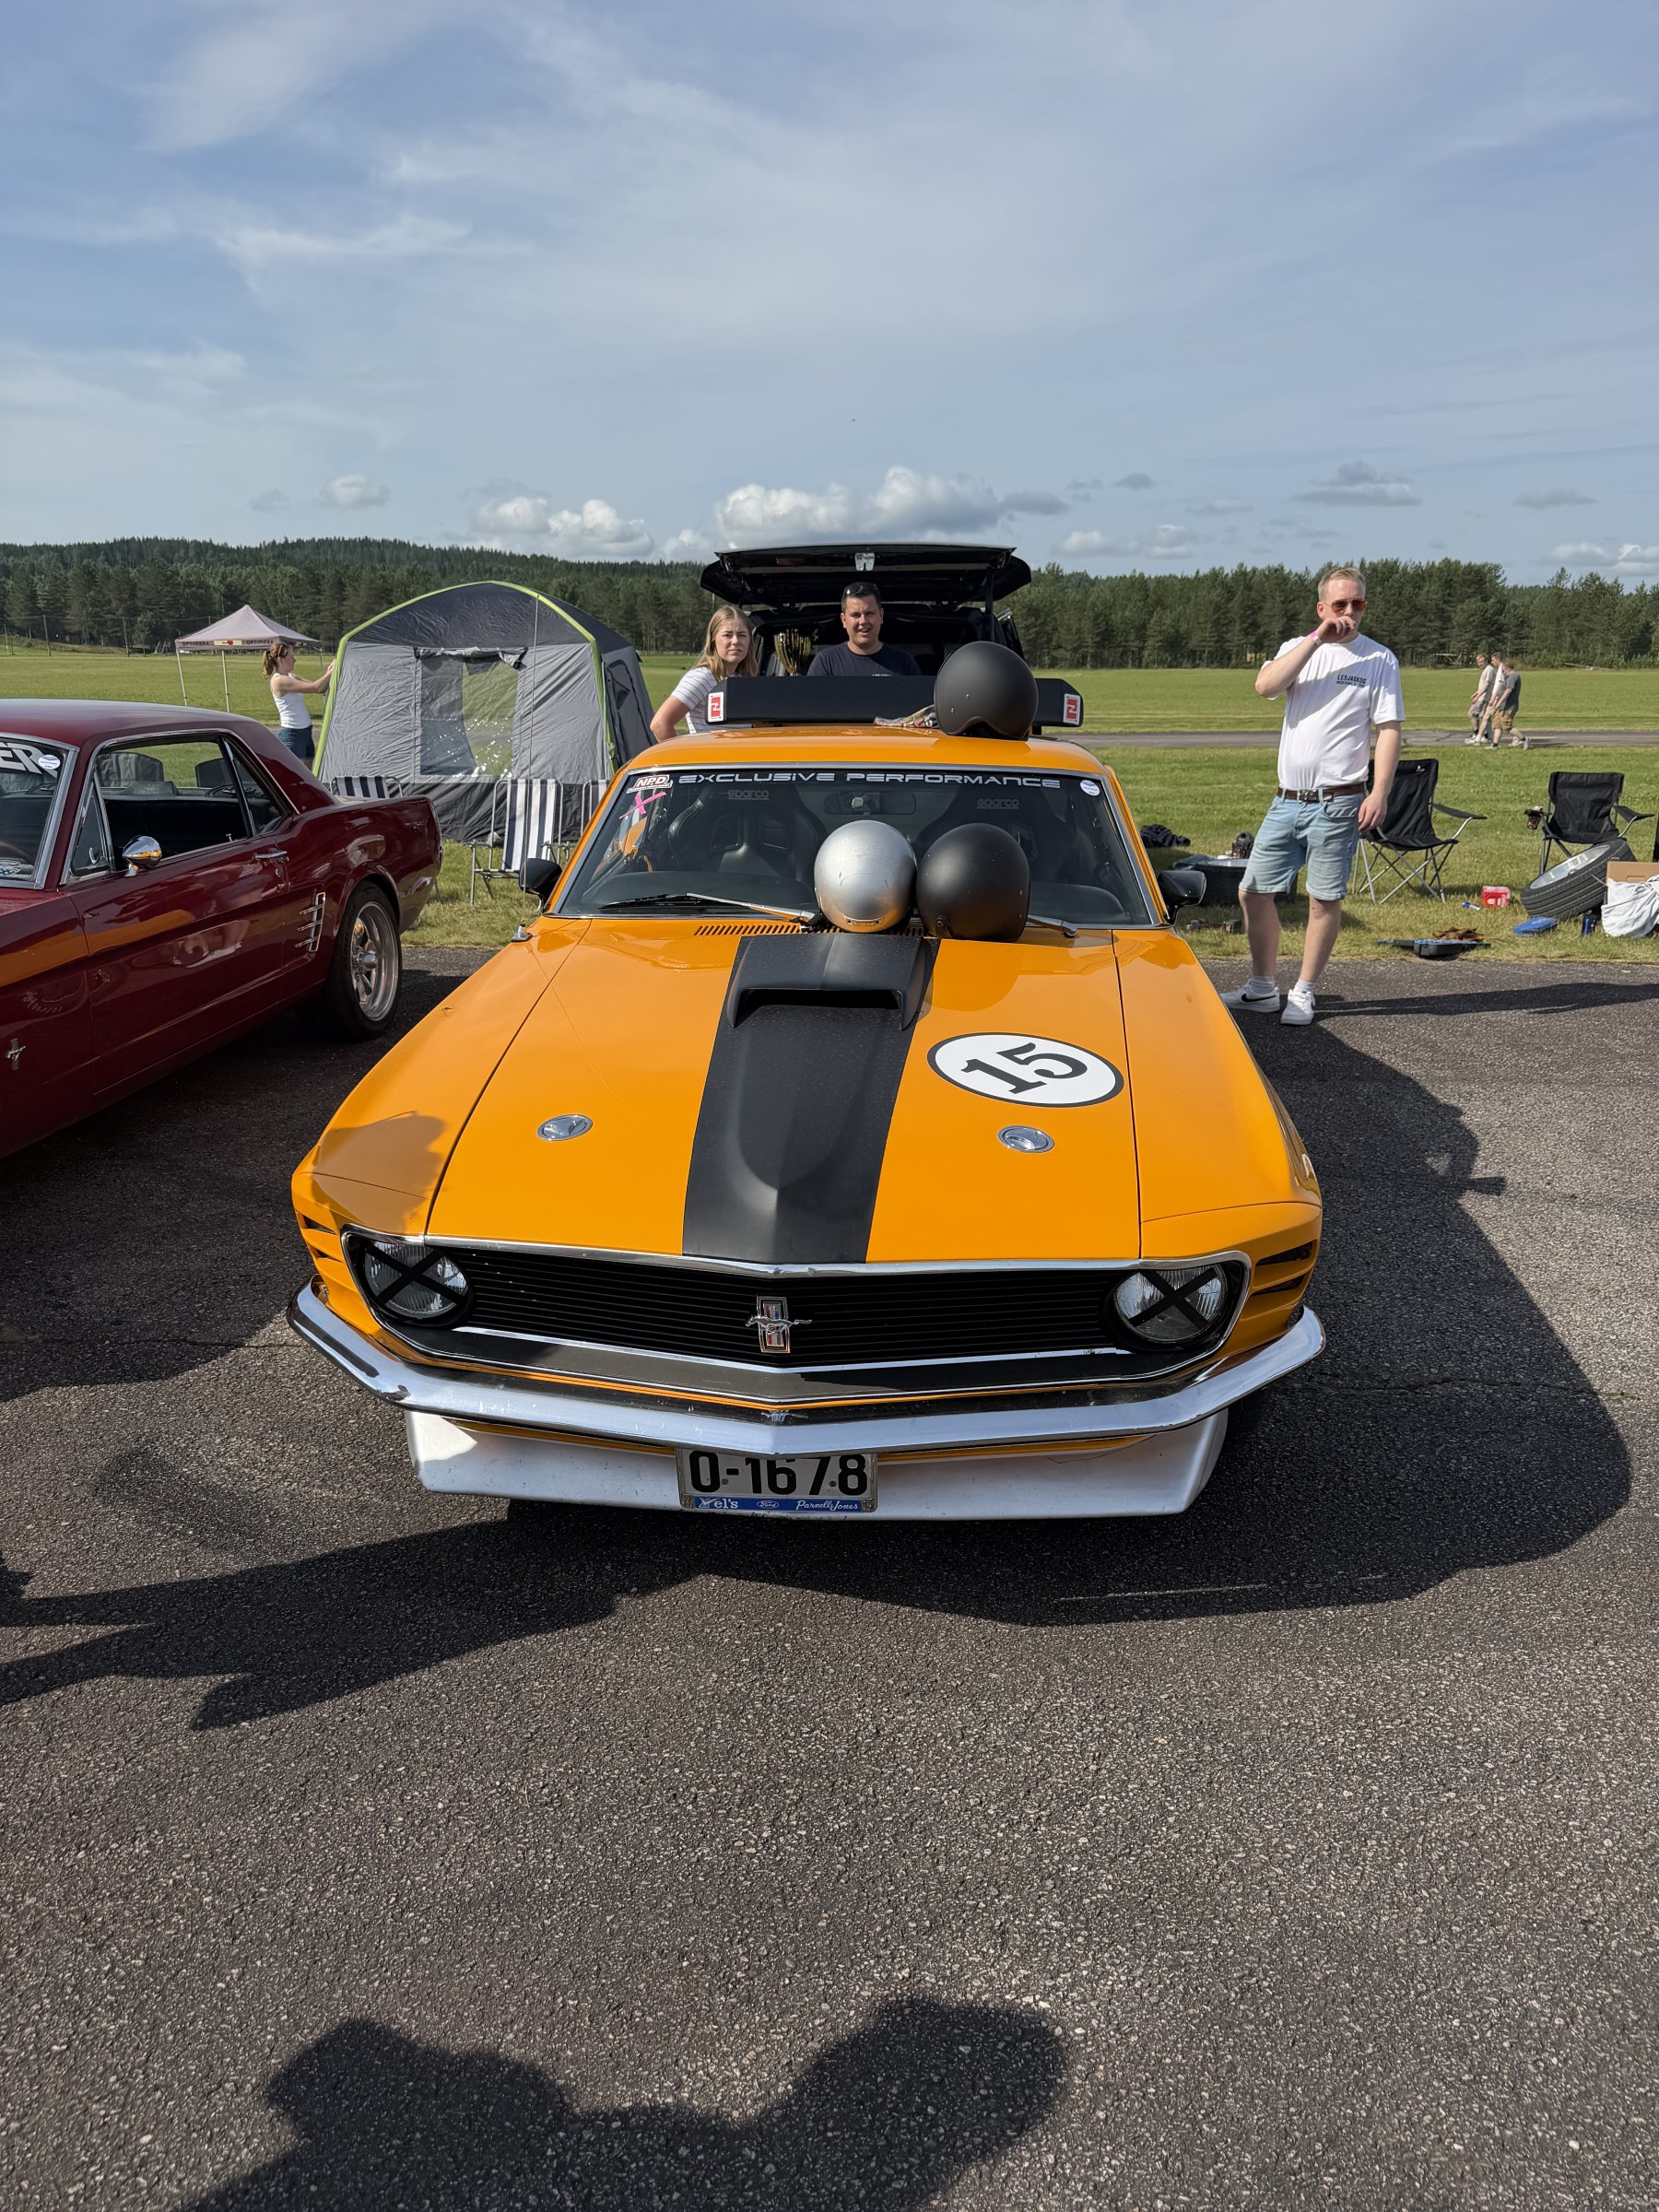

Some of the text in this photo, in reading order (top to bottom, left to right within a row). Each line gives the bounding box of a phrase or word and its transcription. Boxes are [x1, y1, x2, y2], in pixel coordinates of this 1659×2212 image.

[636, 775, 668, 788] NPD
[678, 772, 1061, 789] EXCLUSIVE PERFORMANCE
[727, 789, 770, 801] sparco
[977, 798, 1019, 810] sparco
[960, 1042, 1088, 1094] 15
[759, 1500, 778, 1509] Ford
[830, 1500, 858, 1512] Jones
